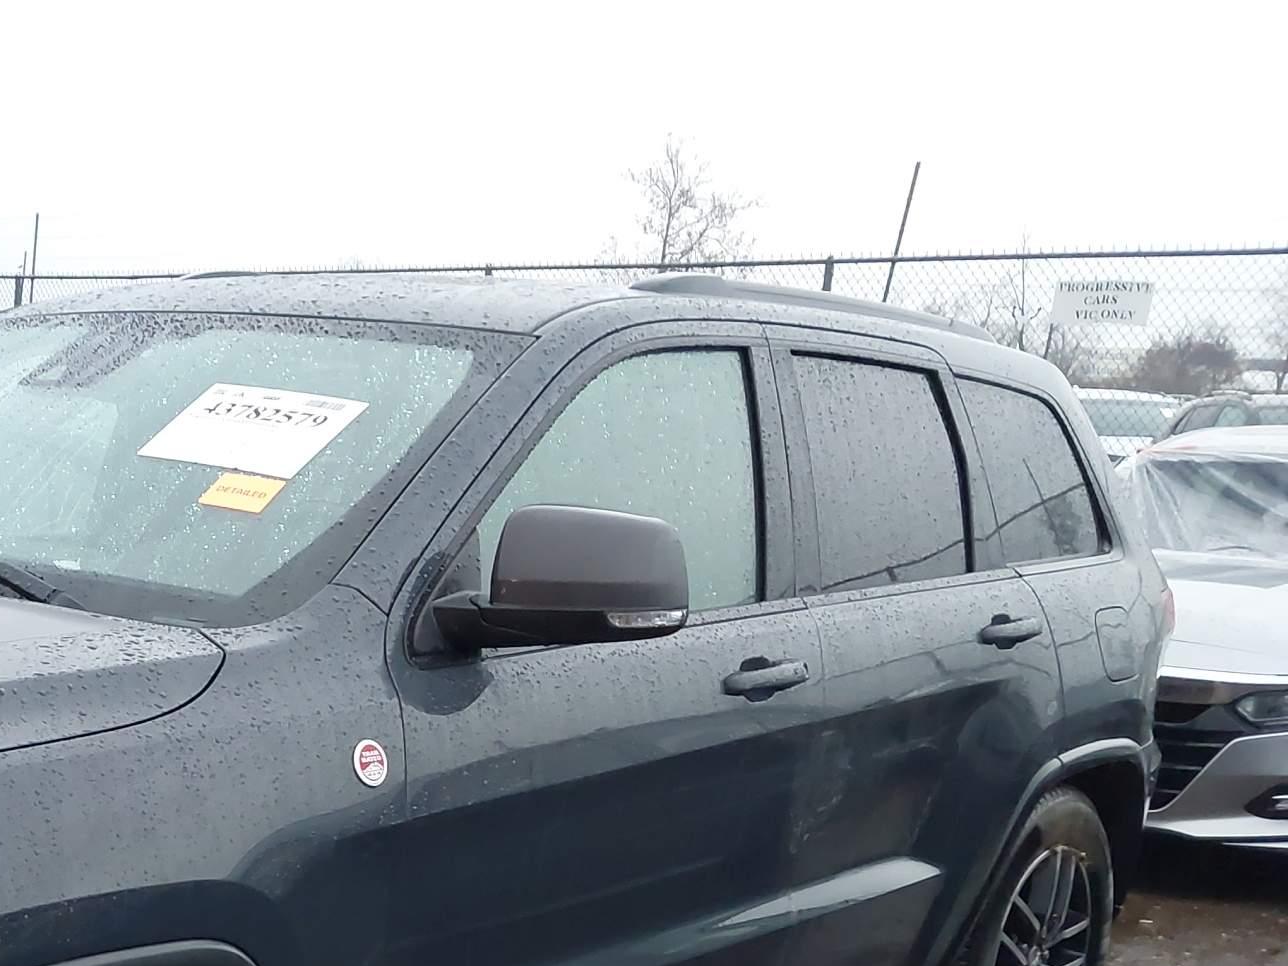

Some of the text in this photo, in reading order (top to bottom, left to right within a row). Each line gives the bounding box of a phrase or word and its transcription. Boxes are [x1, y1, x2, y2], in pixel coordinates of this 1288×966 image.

[1083, 294, 1118, 305] CARS
[1100, 308, 1136, 320] ONLY
[203, 401, 328, 428] 43782579
[215, 484, 268, 499] DETAILED
